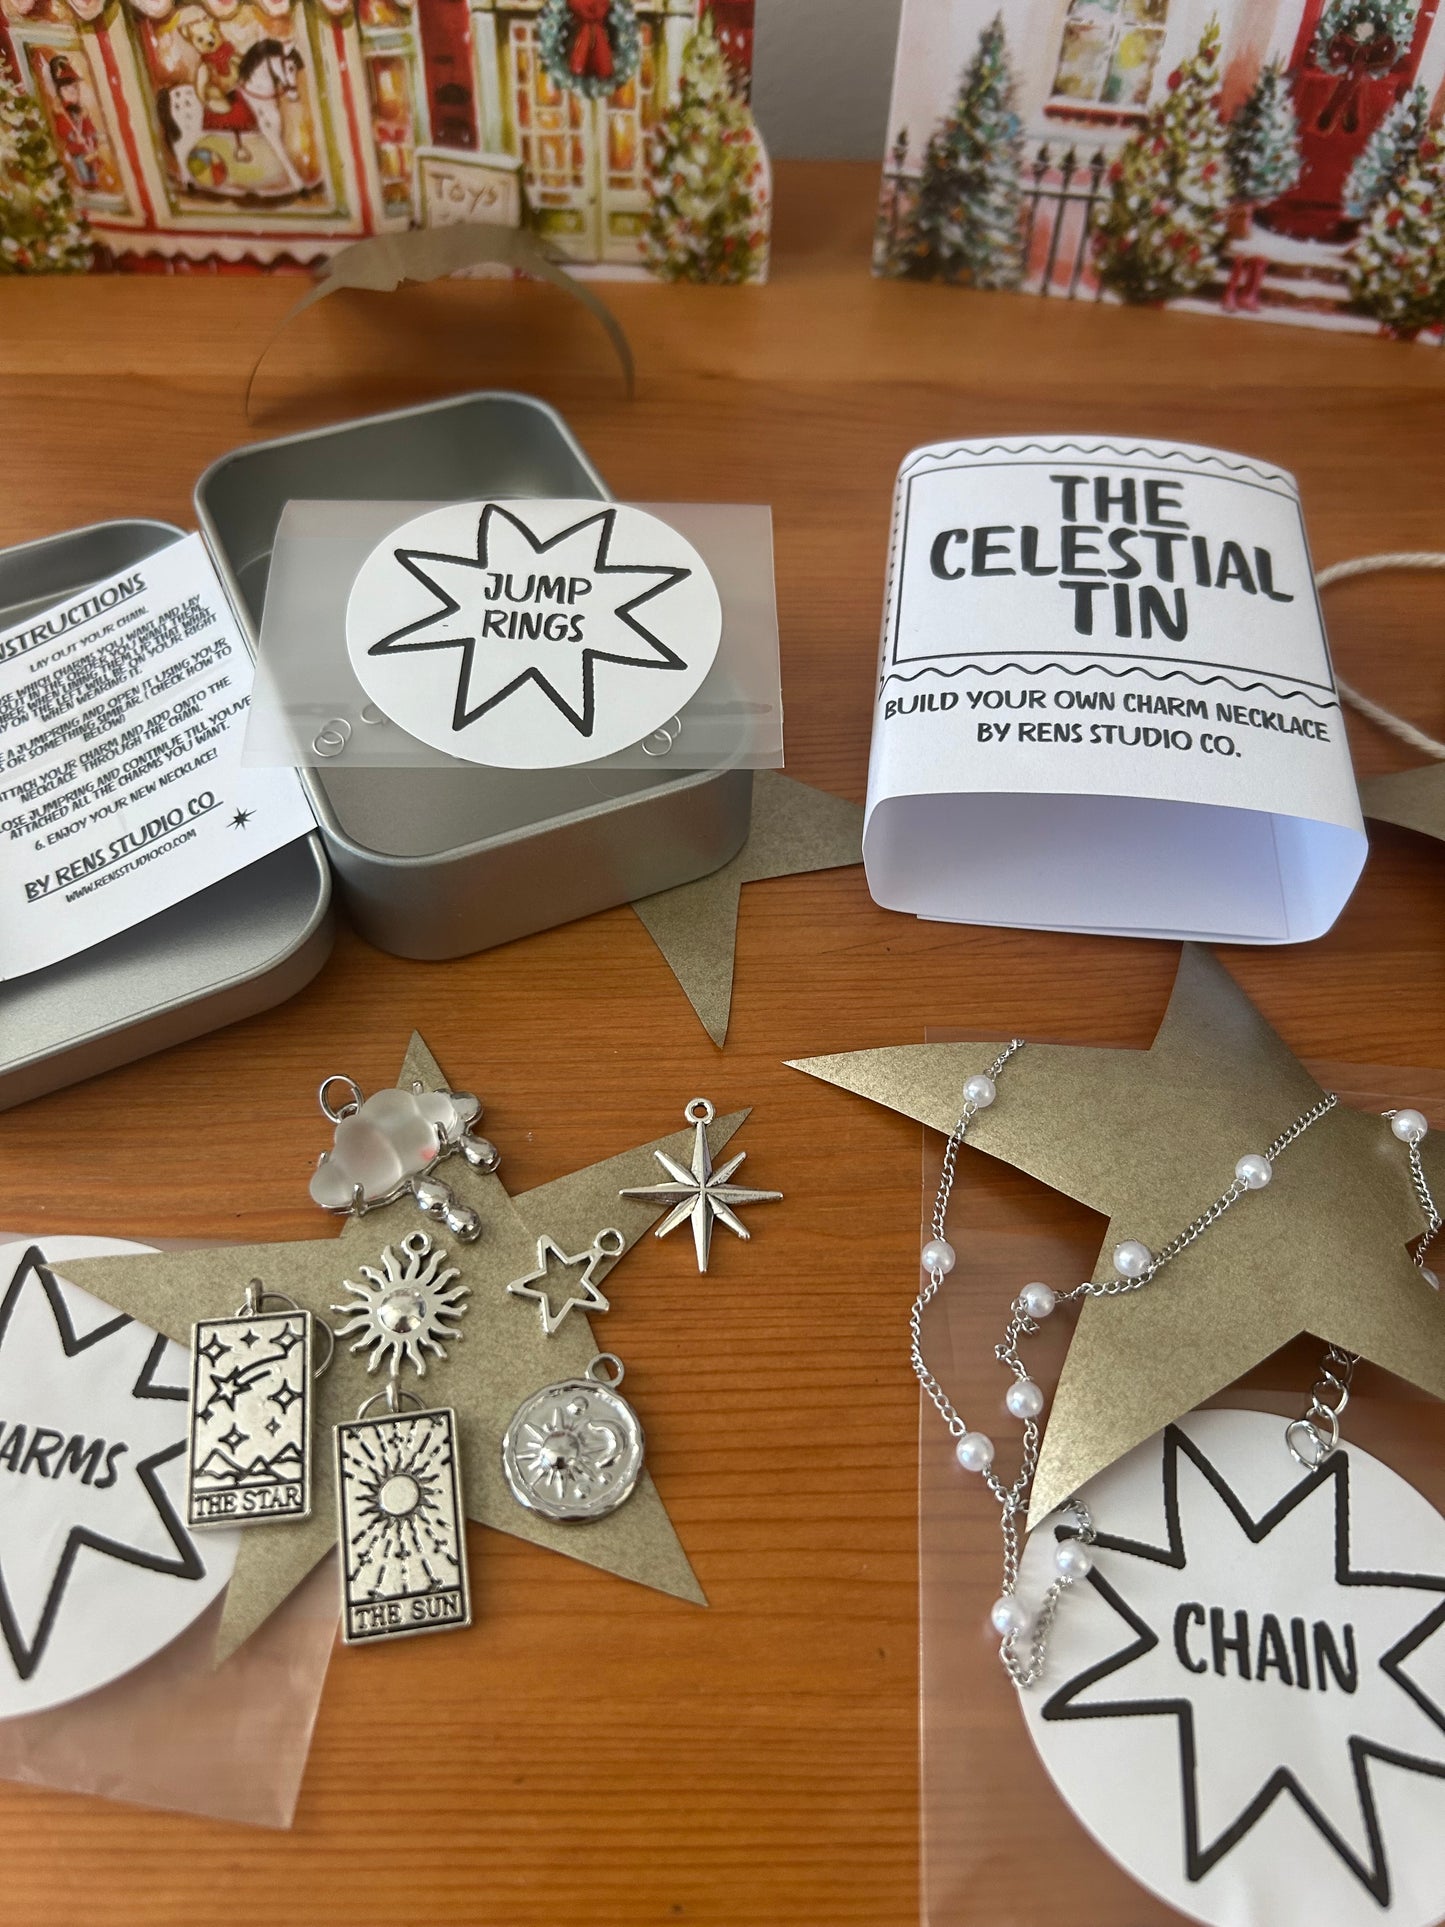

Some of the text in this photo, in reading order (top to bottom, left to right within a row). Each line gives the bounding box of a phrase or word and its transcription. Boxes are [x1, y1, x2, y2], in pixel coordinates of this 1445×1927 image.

[1049, 474, 1190, 530] THE
[484, 572, 592, 605] JUMP
[929, 525, 1294, 602] CELESTIAL
[15, 674, 51, 698] WHICH
[52, 652, 96, 680] CHARMS
[96, 636, 123, 657] YOU
[125, 619, 154, 641] WANT
[158, 606, 179, 625] AND
[181, 594, 199, 611] LAY
[29, 606, 148, 672] LAY OUT YOUR CHAIN.
[482, 609, 586, 642] RINGS
[1058, 580, 1188, 642] TIN
[10, 712, 29, 727] ON
[31, 700, 54, 717] THE
[55, 686, 81, 706] LEFT
[84, 673, 109, 690] WILL
[111, 663, 126, 677] BE
[128, 653, 145, 668] ON
[146, 633, 183, 657] YOUR
[183, 613, 216, 637] RIGHT
[16, 717, 79, 754] JUMPRING
[82, 703, 104, 722] AND
[106, 685, 139, 708] OPEN
[141, 678, 152, 691] IT
[154, 658, 190, 682] USING
[190, 637, 227, 663] YOUR
[26, 688, 59, 710] WHEN
[100, 651, 132, 673] THEM
[132, 640, 153, 656] UP
[153, 625, 178, 644] THAT
[181, 607, 213, 630] WHAT
[28, 688, 40, 700] IN
[41, 677, 64, 693] THE
[66, 655, 108, 681] ORDER
[109, 639, 136, 659] YOU
[138, 622, 167, 644] WANT
[40, 698, 74, 722] WHEN
[75, 672, 126, 704] WEARING
[6, 753, 26, 768] OR
[28, 719, 95, 759] SOMETHING
[185, 655, 213, 676] HOW
[214, 645, 231, 659] TO
[38, 758, 77, 783] YOUR
[78, 737, 118, 764] CHARM
[120, 724, 143, 743] AND
[146, 709, 170, 729] ADD
[172, 690, 206, 713] ONTO
[207, 675, 231, 693] THE
[885, 690, 1331, 742] BUILD YOUR OWN CHARM NECKLACE
[977, 722, 1241, 758] BY RENS STUDIO CO.
[10, 720, 229, 839] ATTACHED ALL THE CHARMS YOU WANT.
[20, 703, 202, 803] NECKLACE THROUGH THE CHAIN.
[28, 781, 94, 820] JUMPRING
[96, 767, 120, 787] AND
[122, 733, 183, 772] CONTINUE
[183, 721, 208, 738] TILL
[46, 817, 86, 845] ENJOY
[88, 796, 128, 822] YOUR
[129, 781, 156, 802] NEW
[158, 747, 217, 786] NECKLACE!
[24, 791, 214, 900] BY RENS STUDIO CO
[65, 828, 196, 902] WWW.RENSSTUDIOCO.COM
[0, 1420, 129, 1489] ARMS
[194, 1486, 303, 1516] THE STAR
[355, 1594, 460, 1629] THE SUN
[1173, 1602, 1358, 1694] CHAIN
